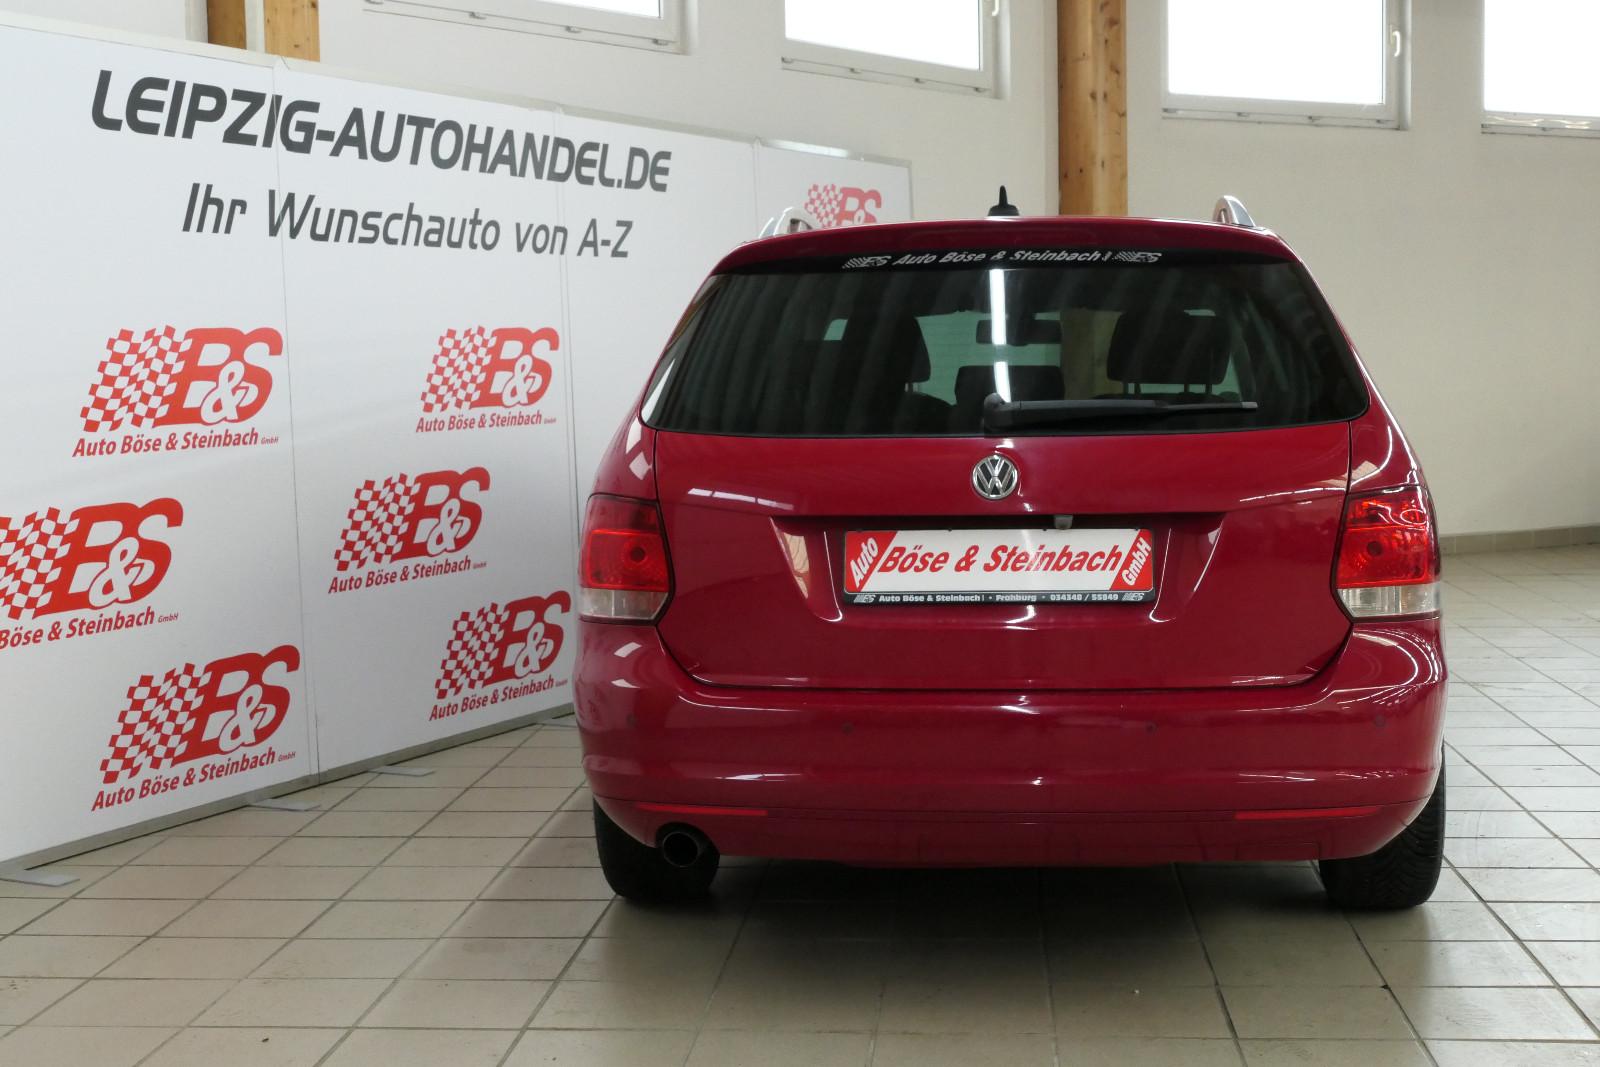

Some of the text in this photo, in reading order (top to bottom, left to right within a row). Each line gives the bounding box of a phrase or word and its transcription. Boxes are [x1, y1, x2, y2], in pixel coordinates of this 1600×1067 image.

[91, 69, 672, 193] LEIPZIG-AUTOHANDEL.DE
[182, 183, 633, 259] Ihr Wunschauto von A-Z
[892, 253, 938, 265] Auto
[939, 251, 986, 263] Böse
[990, 250, 1007, 260] &
[1009, 250, 1102, 261] Steinbach
[416, 417, 445, 432] Auto
[448, 414, 475, 430] Böse
[478, 413, 487, 428] &
[489, 410, 542, 428] Steinbach
[72, 438, 116, 457] Auto
[121, 434, 161, 454] Böse
[165, 432, 178, 450] &
[181, 427, 259, 449] Steinbach
[328, 576, 362, 594] Auto
[365, 570, 397, 588] Böse
[400, 565, 410, 582] &
[412, 555, 471, 580] Steinbach
[850, 536, 1152, 588] Auto Böse & Steinbach GmbH
[879, 594, 900, 602] Auto
[935, 593, 981, 602] Steinbach
[48, 621, 62, 641] &
[66, 606, 155, 639] Steinbach
[158, 612, 179, 623] GmbH
[429, 702, 458, 721] Auto
[461, 694, 488, 713] Böse
[490, 688, 499, 704] &
[501, 674, 554, 702] Steinbach
[91, 786, 135, 811] Auto
[139, 775, 179, 799] Böse
[183, 767, 195, 787] &
[199, 747, 276, 783] Steinbach
